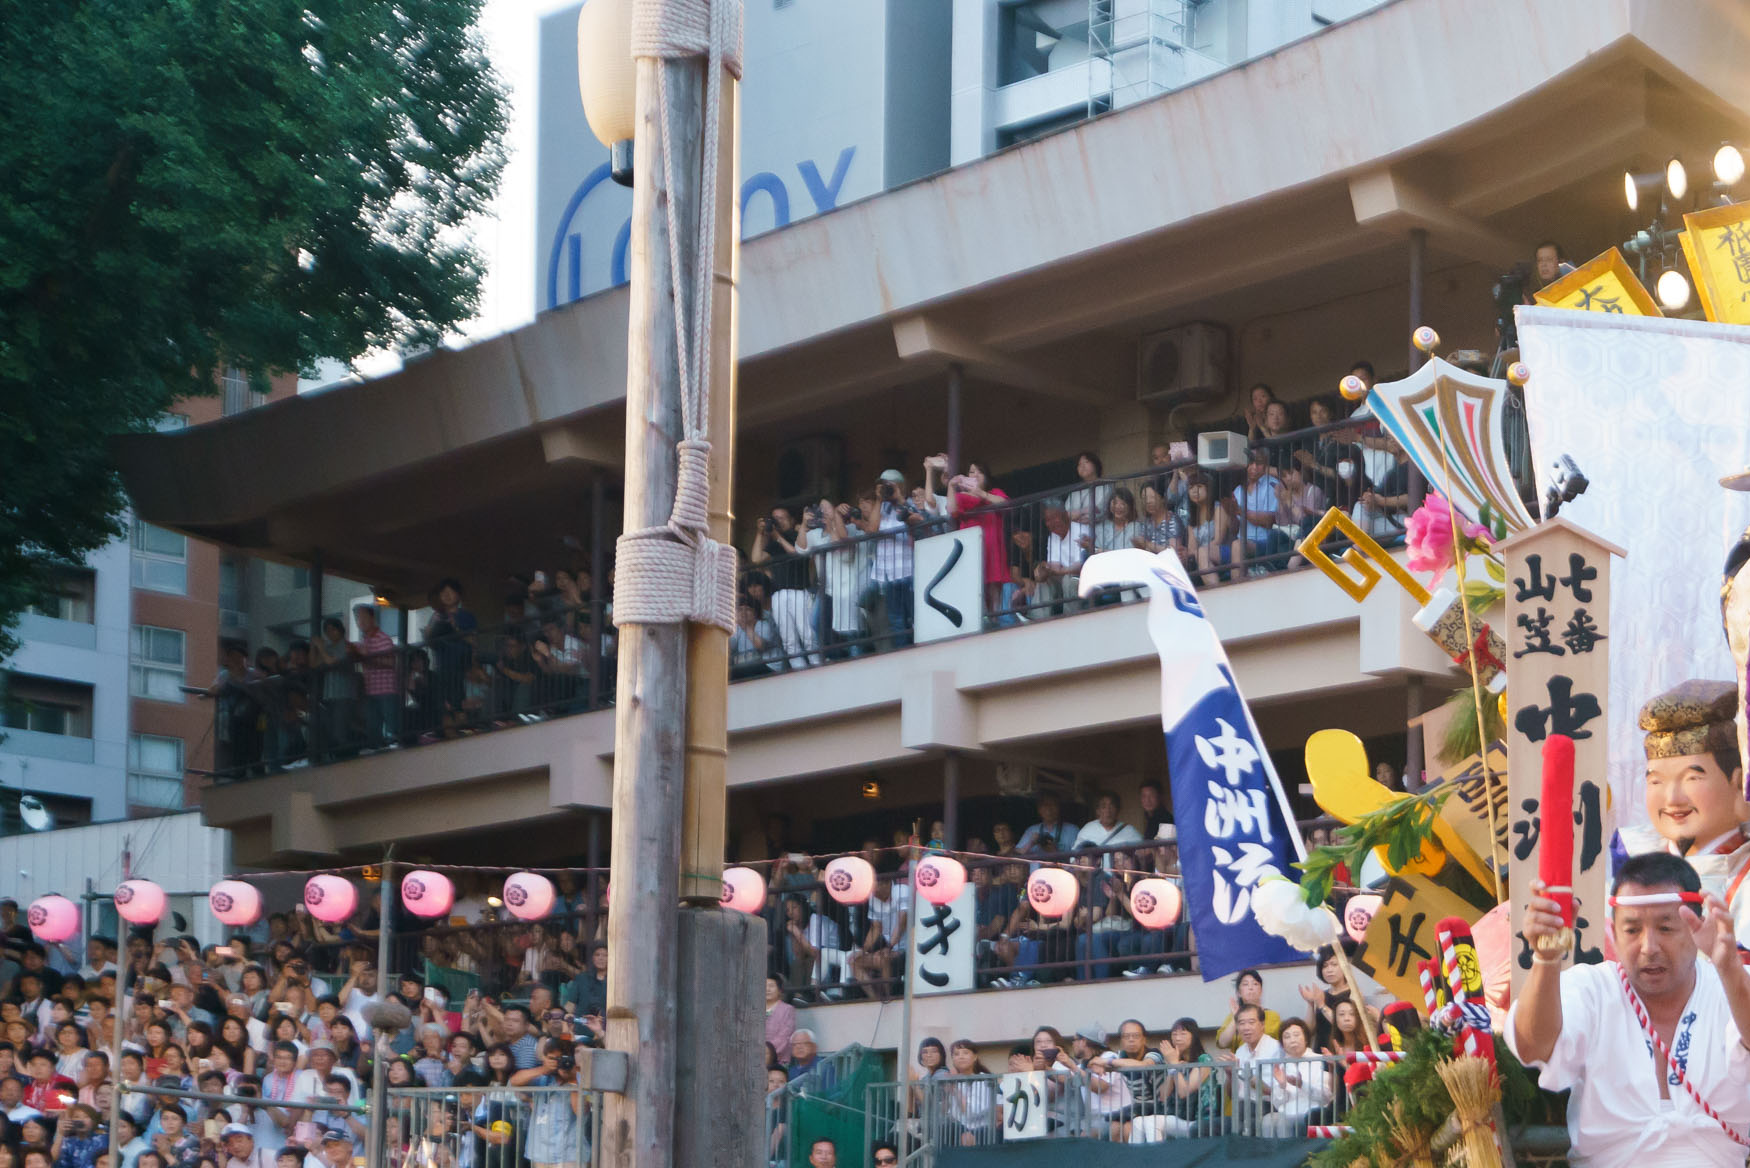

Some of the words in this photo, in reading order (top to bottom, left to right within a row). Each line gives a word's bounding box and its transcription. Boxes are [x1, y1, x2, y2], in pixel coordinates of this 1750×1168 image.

[925, 538, 963, 628] く
[1513, 554, 1565, 658] 山笠
[1560, 553, 1608, 655] 七番
[918, 904, 961, 987] き
[1006, 1077, 1041, 1133] か
